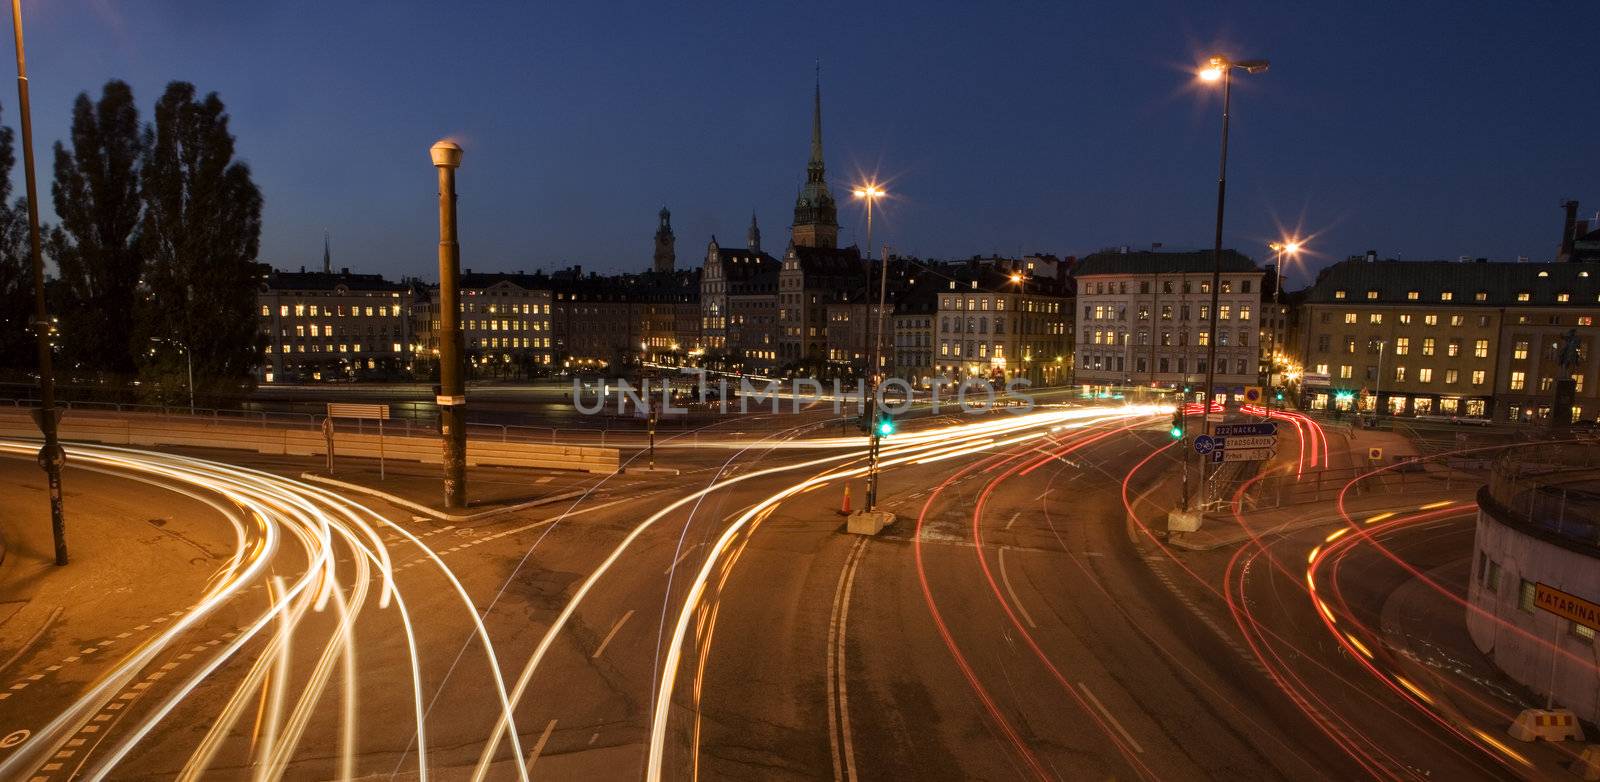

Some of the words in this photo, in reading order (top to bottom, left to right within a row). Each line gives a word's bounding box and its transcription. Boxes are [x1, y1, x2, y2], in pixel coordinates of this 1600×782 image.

[1216, 427, 1229, 435] 222
[1233, 426, 1257, 434] NACKA
[1215, 451, 1221, 462] P
